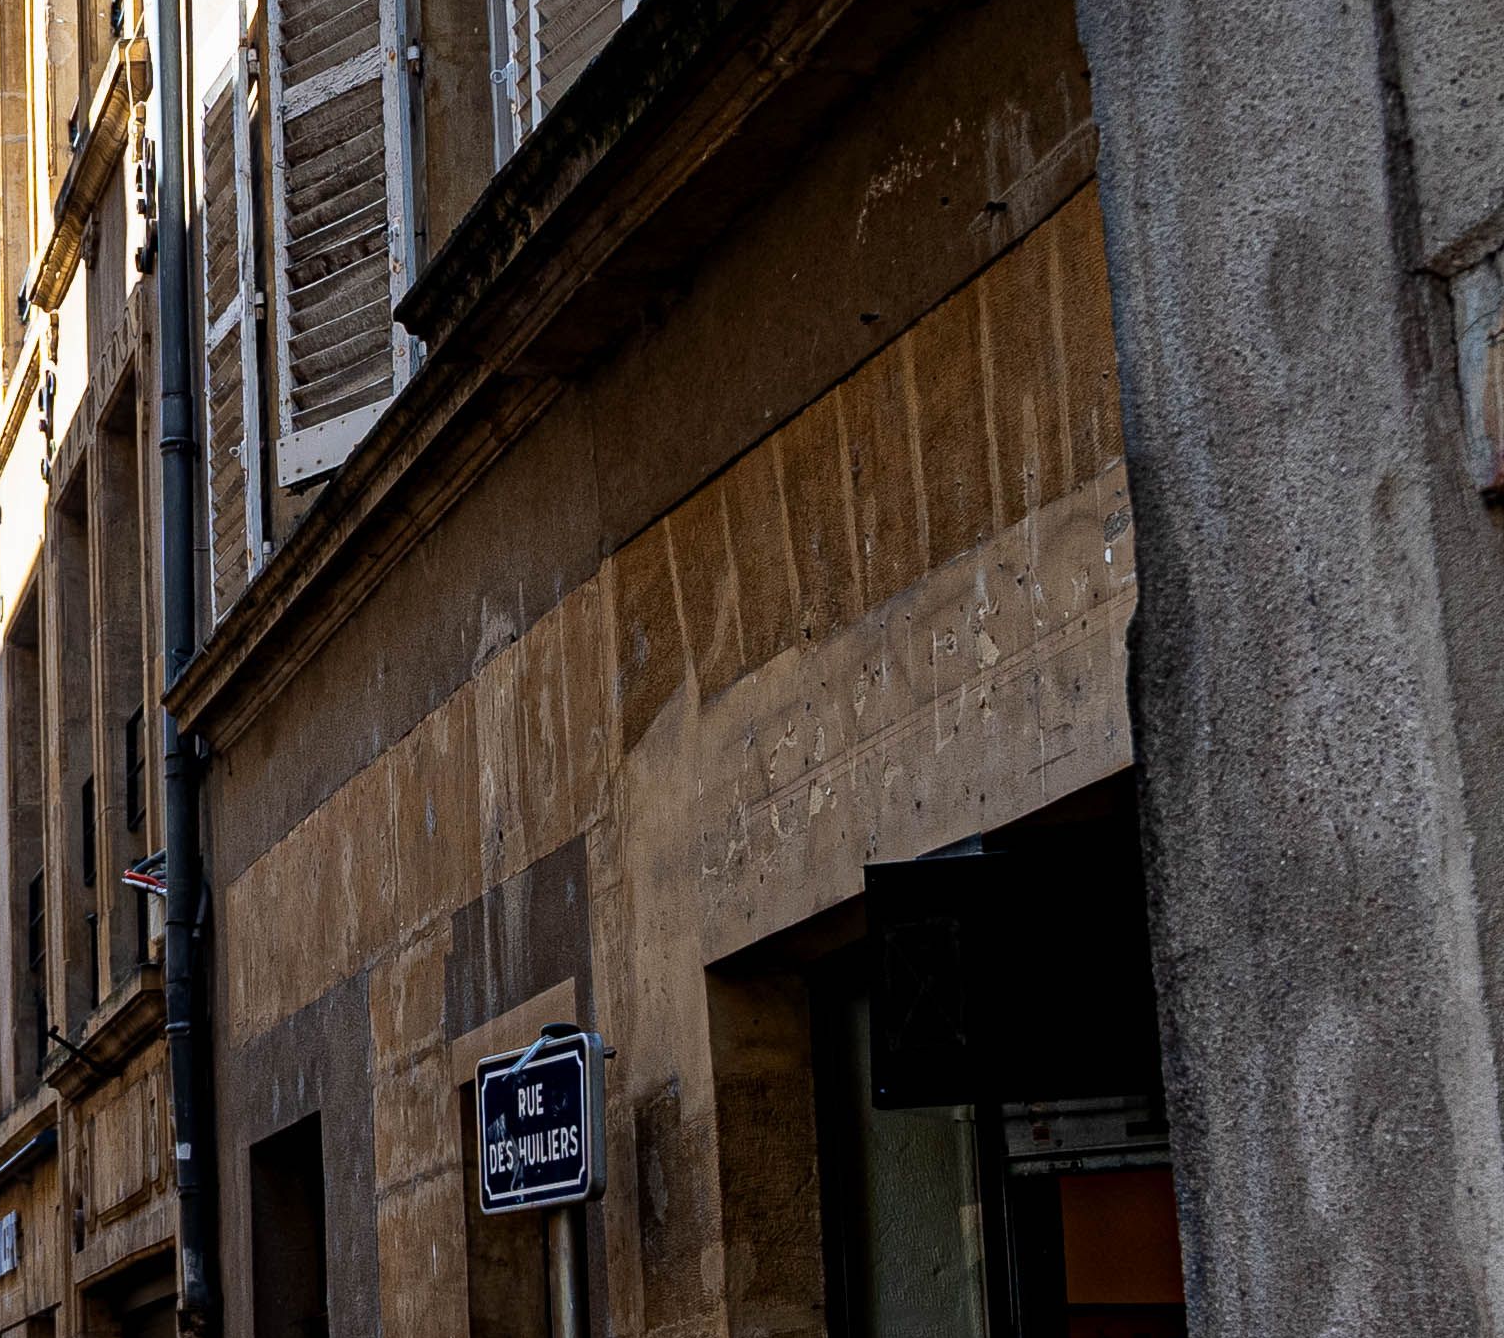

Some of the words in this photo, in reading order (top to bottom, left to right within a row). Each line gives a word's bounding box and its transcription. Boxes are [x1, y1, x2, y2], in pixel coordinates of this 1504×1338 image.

[517, 1083, 544, 1118] RUE
[489, 1138, 514, 1175] DES
[518, 1124, 578, 1167] HUILIERS
